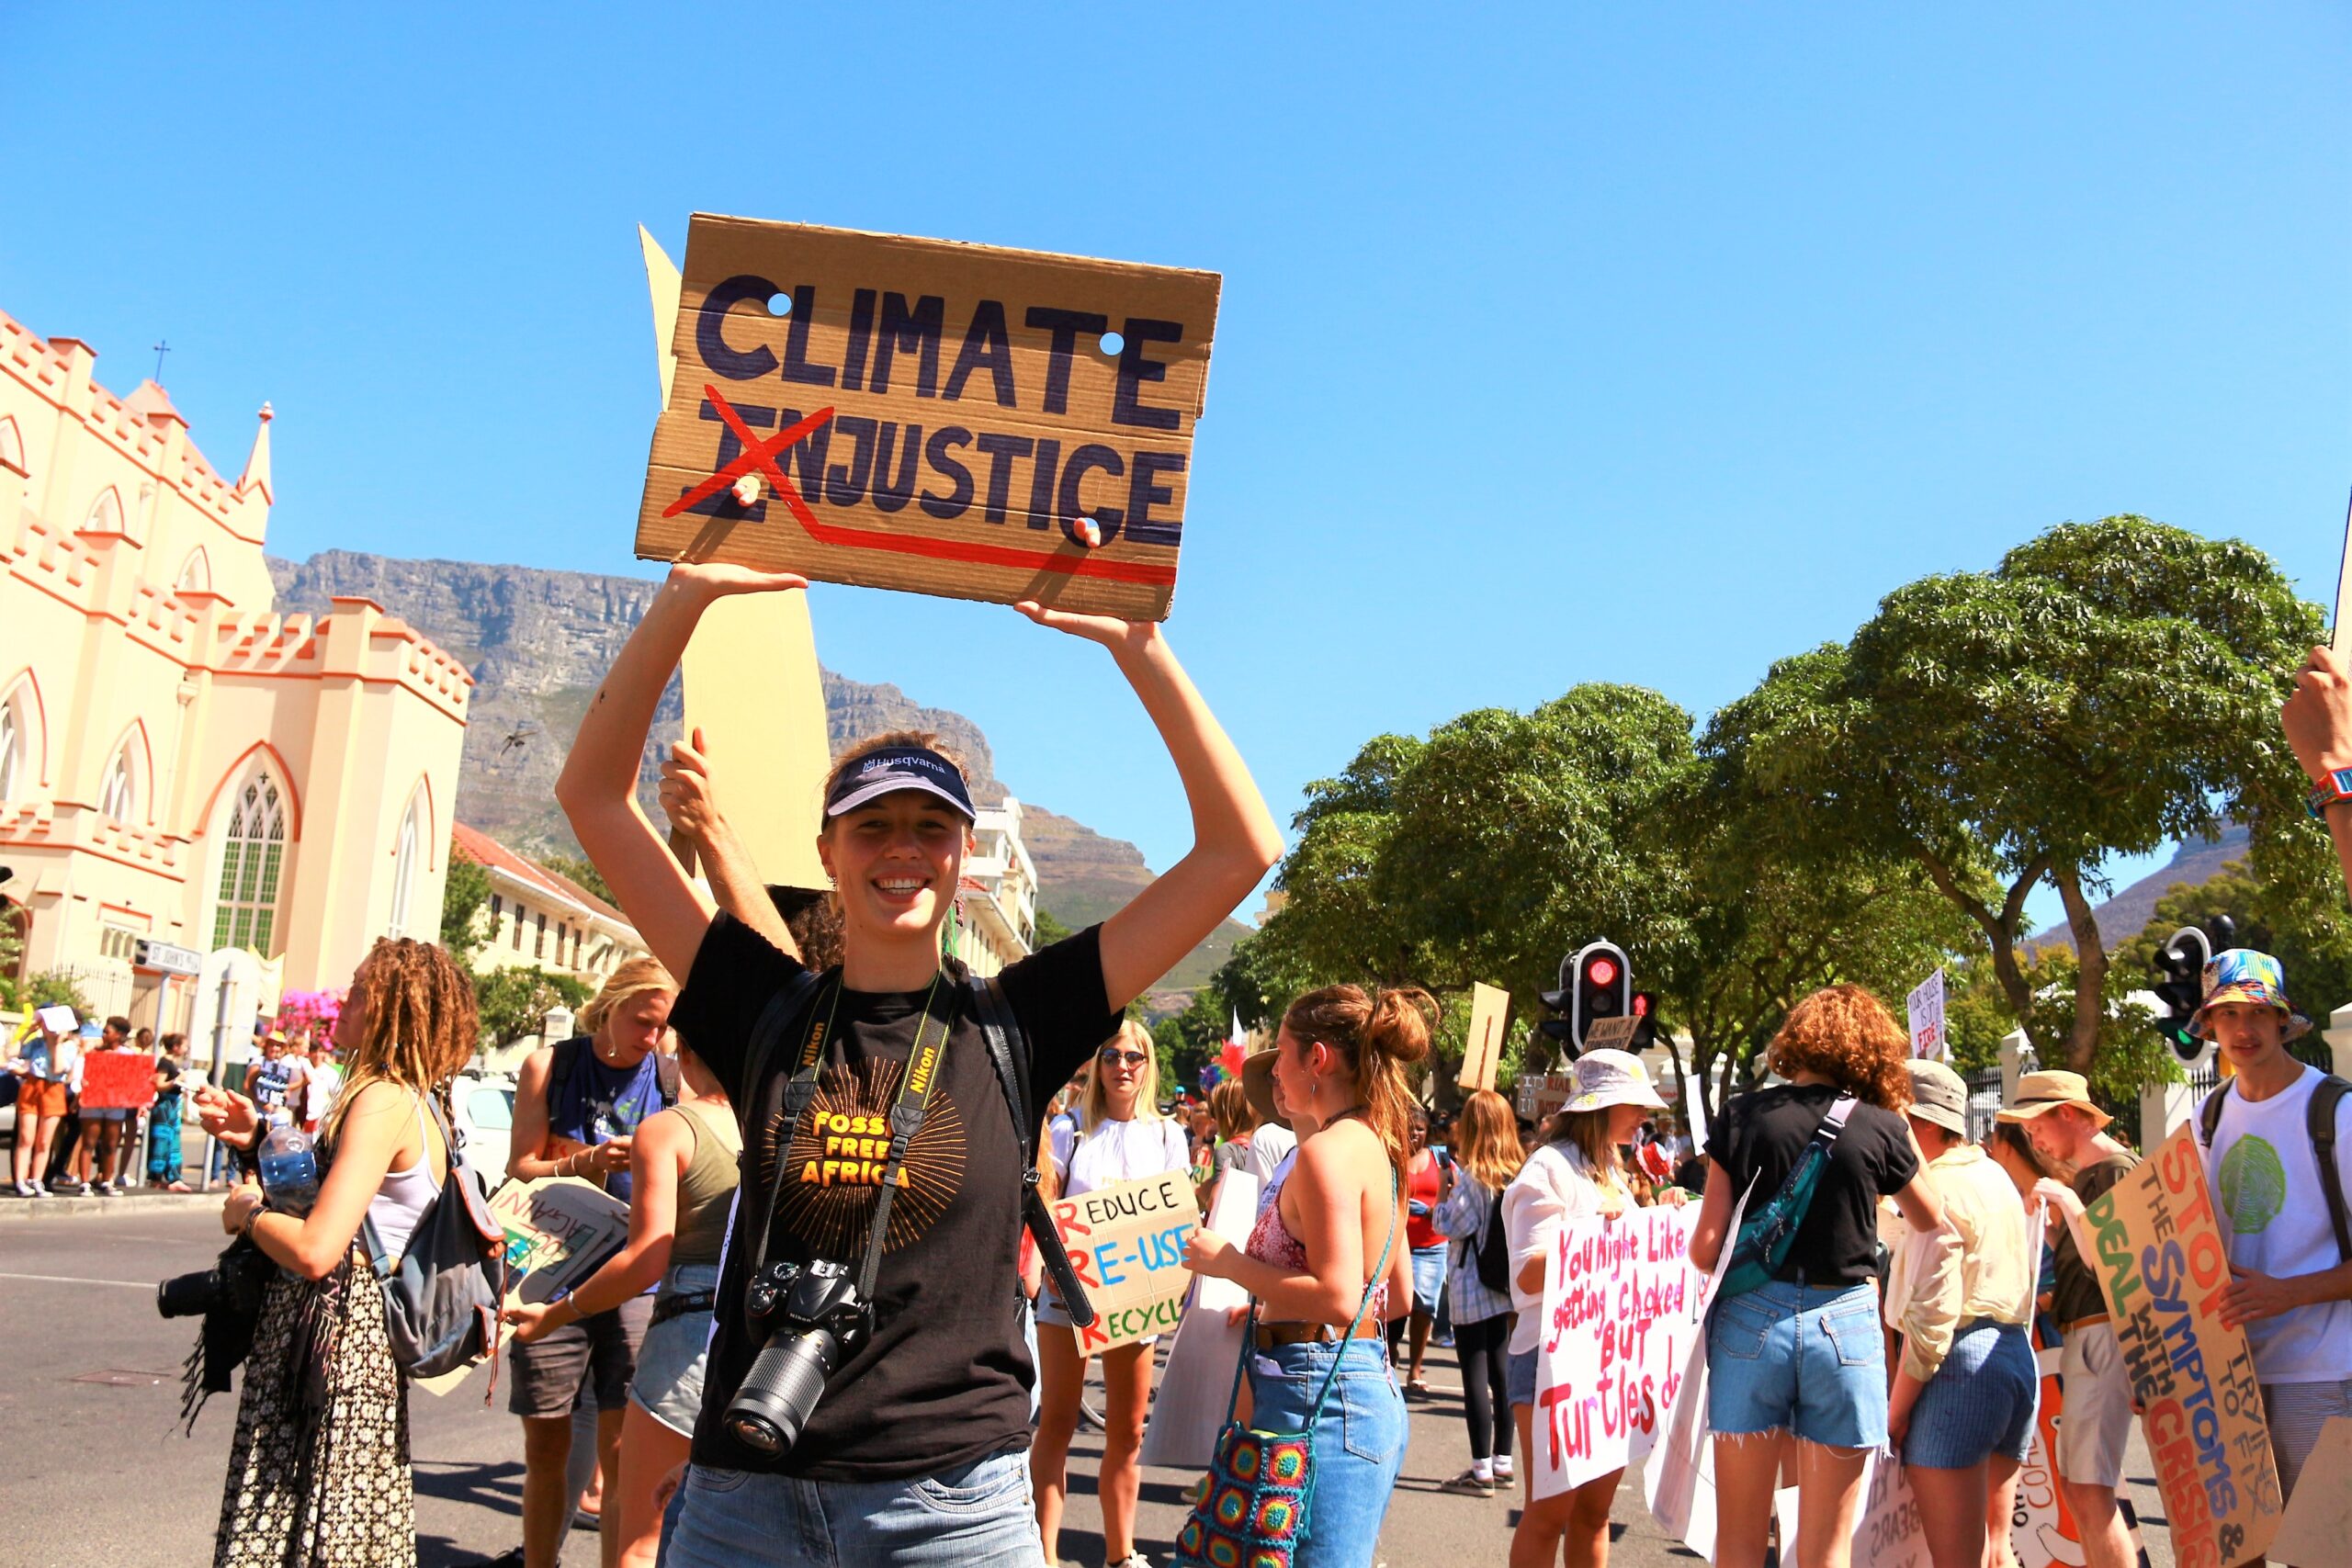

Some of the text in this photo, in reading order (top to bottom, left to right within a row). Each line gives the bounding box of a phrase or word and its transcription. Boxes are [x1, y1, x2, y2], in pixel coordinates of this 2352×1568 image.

[695, 274, 1183, 431] CLIMATE
[876, 756, 946, 774] Husqvarna
[801, 1021, 825, 1067] Nikon
[1917, 1021, 1936, 1052] FIRE
[910, 1046, 935, 1094] Nikon
[825, 1135, 891, 1160] FREE
[799, 1160, 912, 1190] AFRICA
[1054, 1181, 1180, 1245] REDUCE
[1646, 1214, 1687, 1263] Like
[789, 1312, 812, 1323] Nikon
[1545, 1279, 1606, 1354] getting
[2085, 1190, 2177, 1397] DEAL WITH
[1081, 1298, 1181, 1350] RECYCL
[1600, 1317, 1652, 1374] BUT
[2118, 1312, 2159, 1408] THE
[2140, 1162, 2245, 1565] THE SYMPTOMS &
[2219, 1359, 2241, 1417] TO
[1539, 1364, 1655, 1472] Turtles
